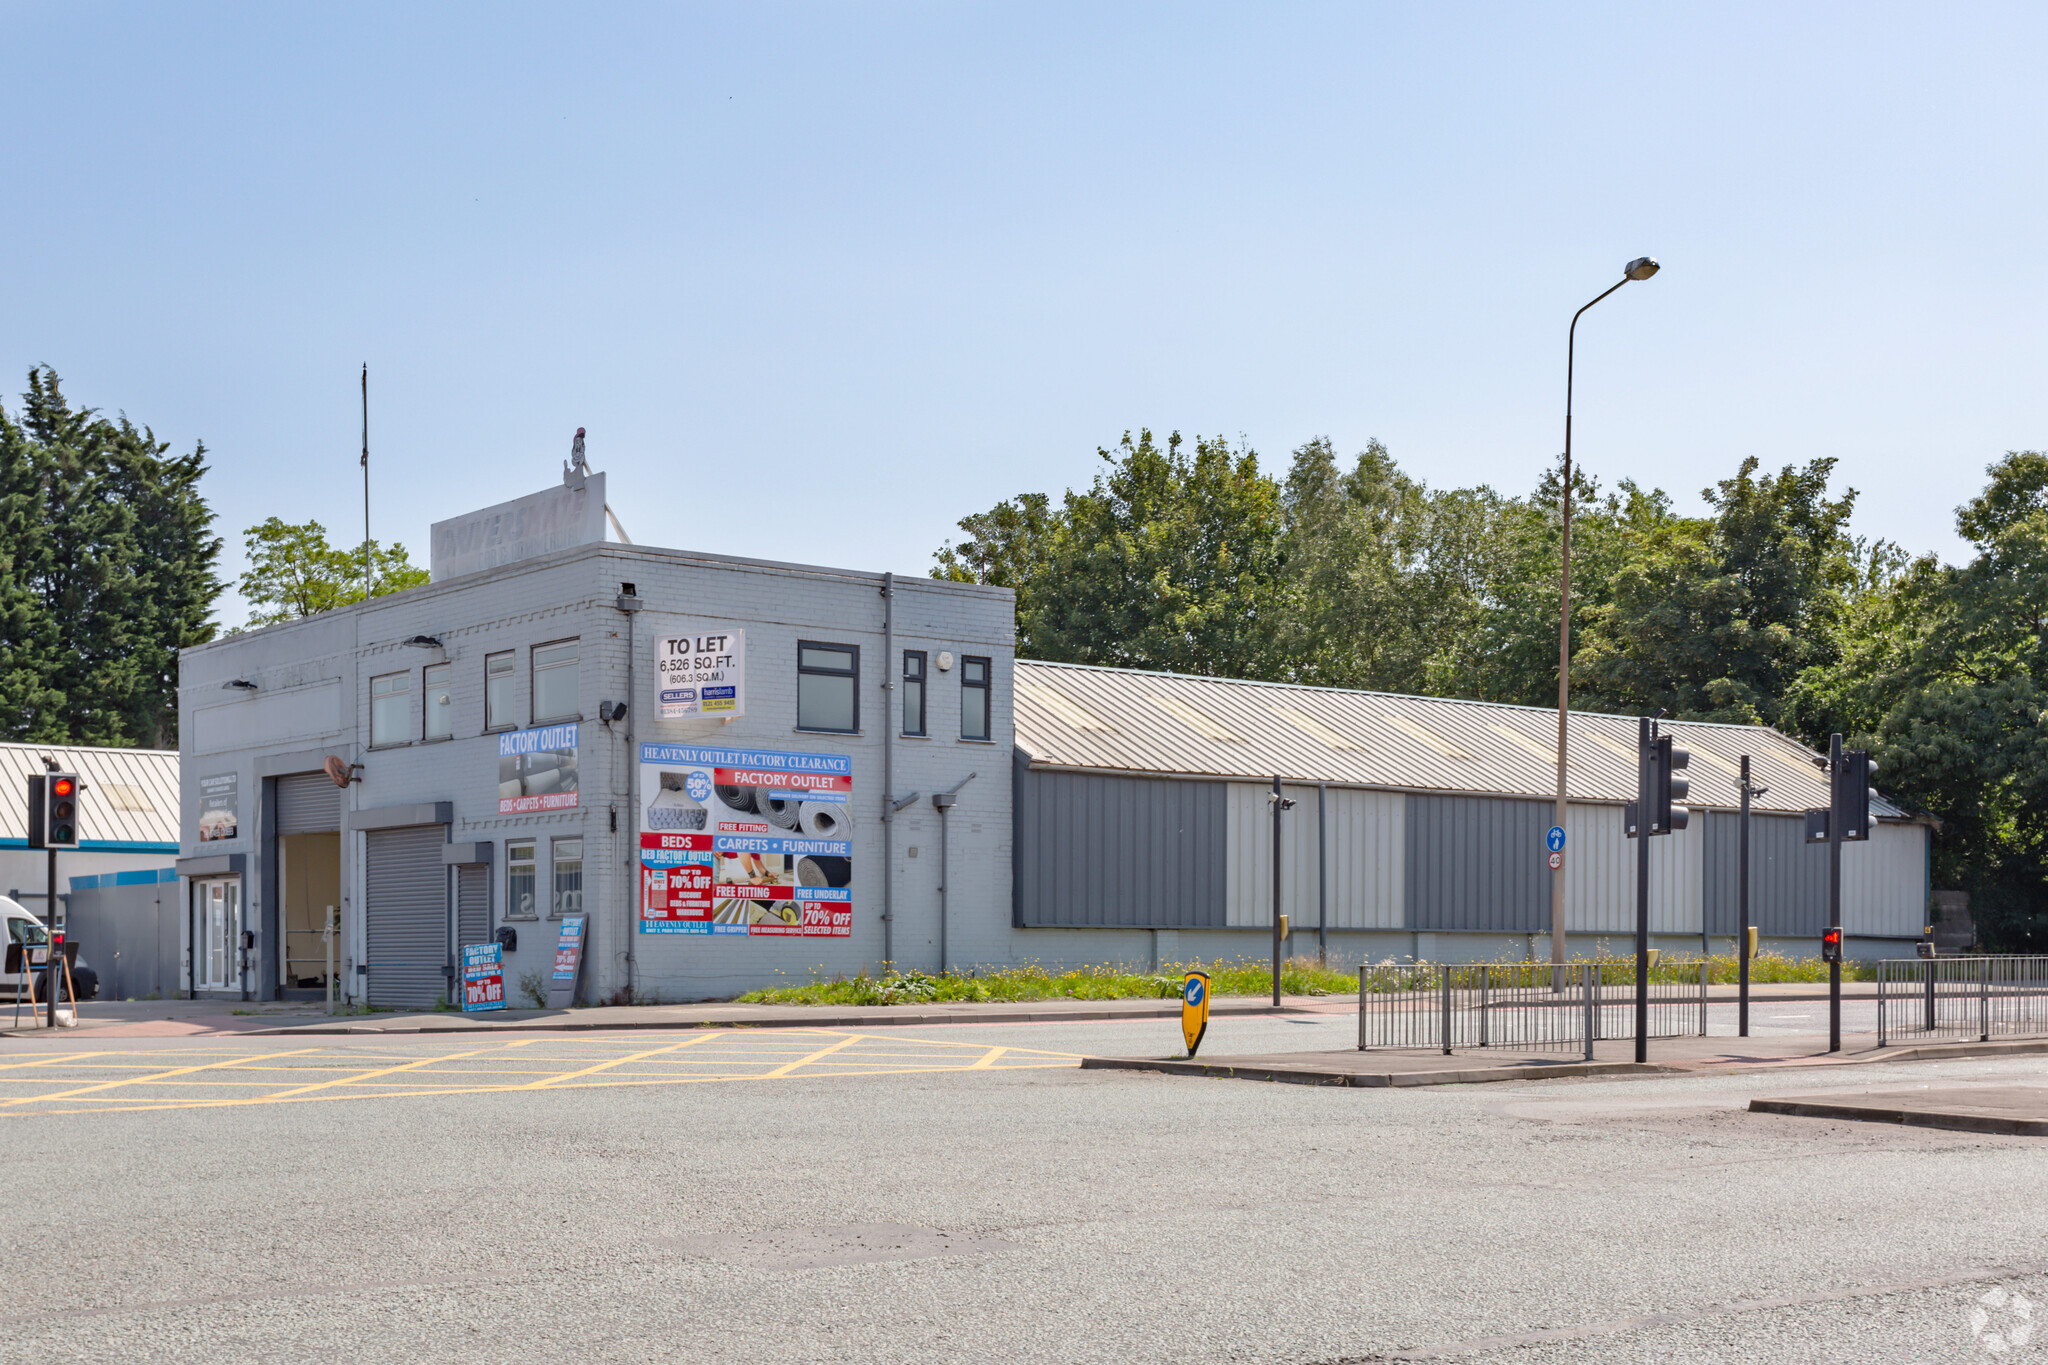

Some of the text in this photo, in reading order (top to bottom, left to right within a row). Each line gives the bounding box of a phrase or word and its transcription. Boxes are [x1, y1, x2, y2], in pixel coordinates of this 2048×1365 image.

[668, 636, 727, 655] TO LET
[660, 655, 735, 674] 6,526 SQ.FT.
[669, 670, 724, 685] (606.3 SQ.M.)
[500, 725, 577, 755] FACTORY OUTLET
[644, 747, 847, 771] HEAVENLY OUTLET FACTORY CLEARANCE
[687, 778, 711, 790] 50%
[735, 772, 834, 789] FACTORY OUTLET
[691, 789, 707, 798] OFF
[500, 793, 577, 812] BEDS CARPETS FURNITURE
[719, 822, 767, 832] FREE FITTING
[661, 836, 692, 848] BEDS
[718, 838, 846, 854] CARPETS FURNITURE
[641, 849, 712, 862] BED FACTORY OUTLET
[670, 875, 711, 889] 70% OFF
[715, 886, 770, 898] FREE FITTING
[797, 889, 848, 899] FREE UNDERLAY
[804, 910, 851, 925] 70% OFF
[714, 925, 726, 933] FREE
[804, 926, 850, 935] SELECTED ITEMS
[465, 945, 498, 957] FACTORY
[469, 954, 495, 965] OUTLET
[467, 983, 501, 1003] 70% OFF
